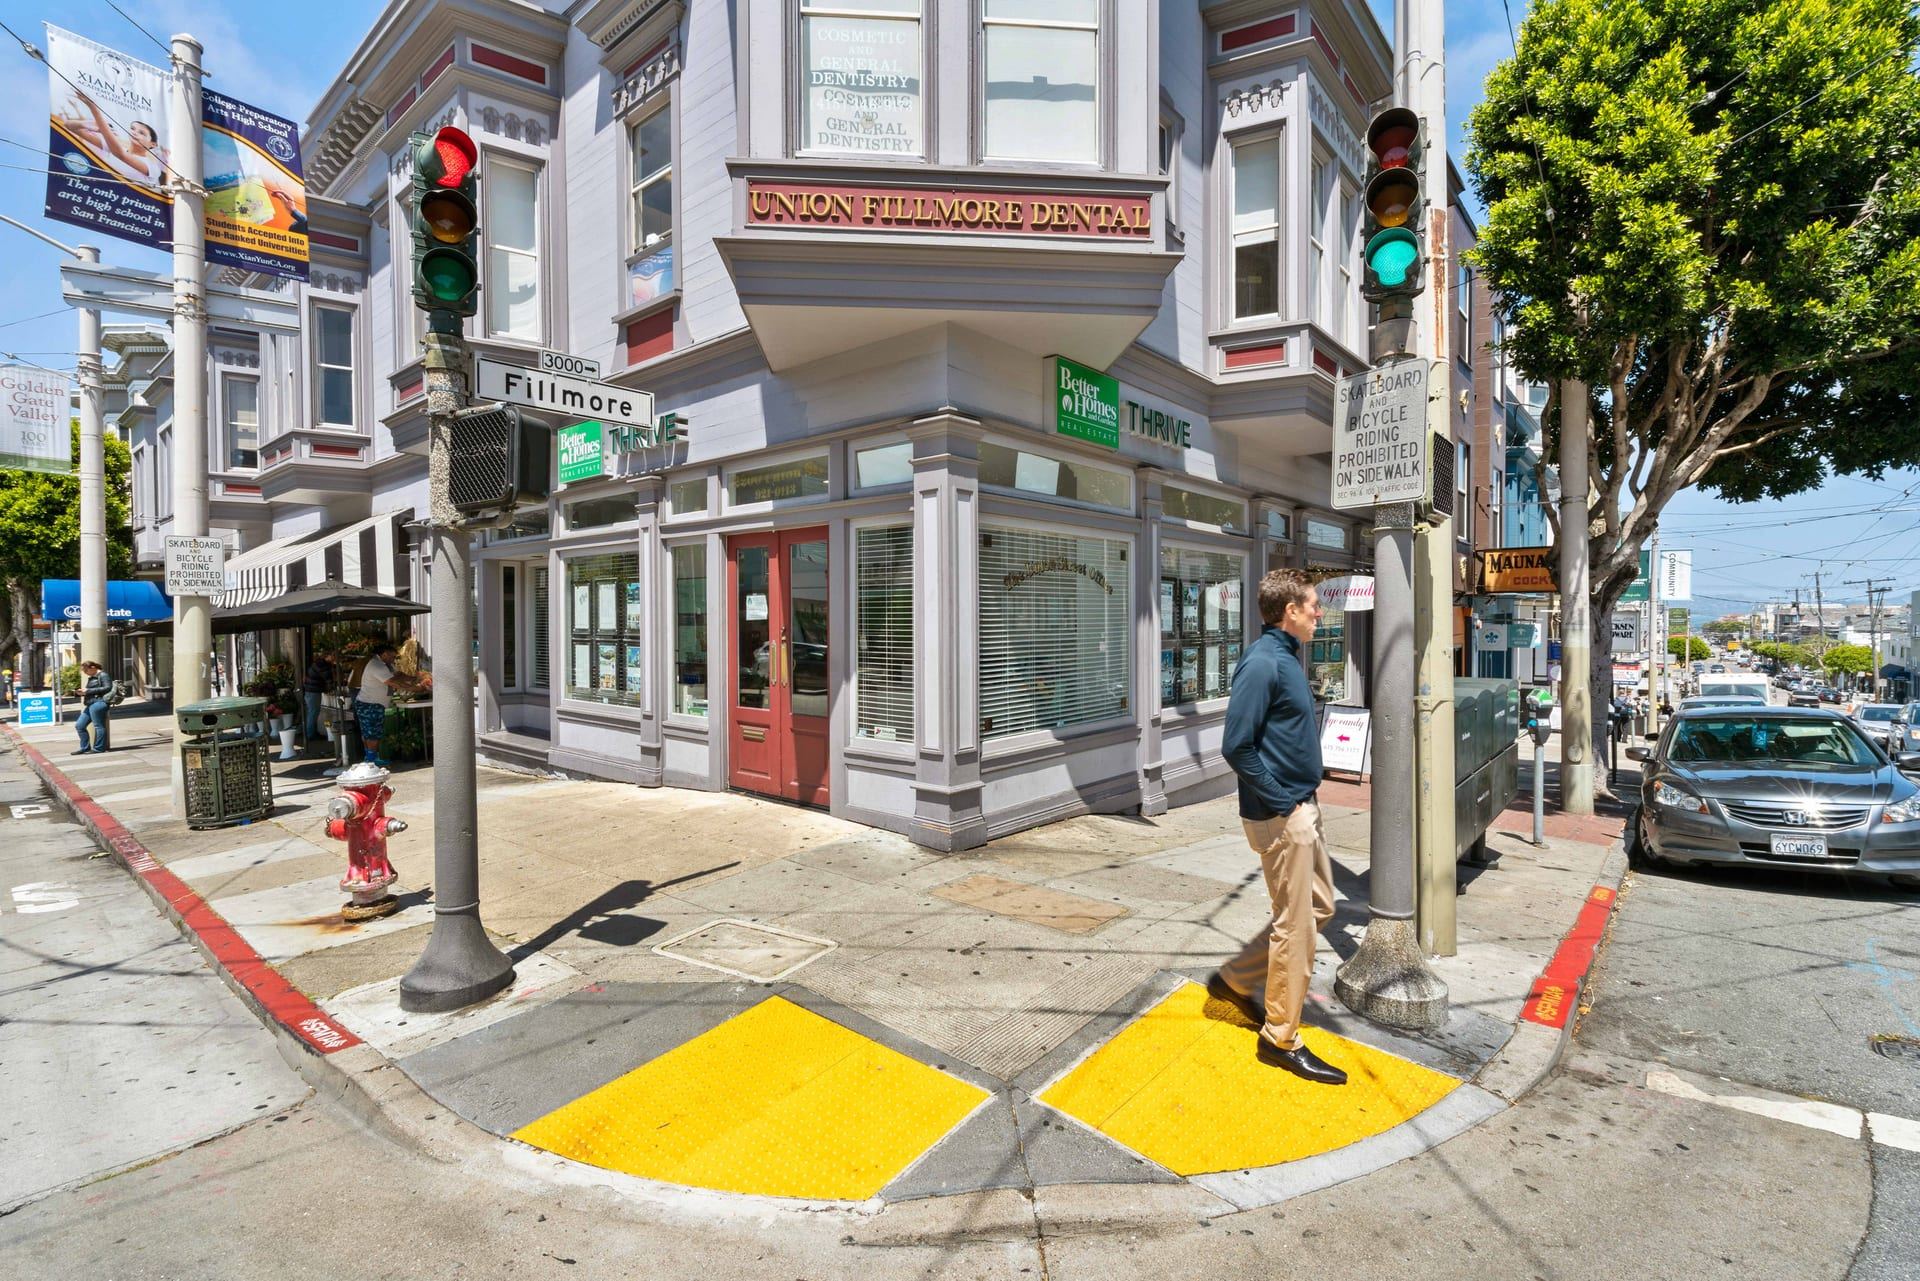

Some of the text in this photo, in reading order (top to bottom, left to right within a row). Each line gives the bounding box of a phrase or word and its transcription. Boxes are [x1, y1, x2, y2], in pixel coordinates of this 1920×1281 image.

[817, 28, 906, 44] COSMETIC
[848, 46, 873, 55] AND
[820, 56, 898, 72] GENERAL
[78, 69, 152, 107] XIAN YUN
[811, 71, 910, 88] DENTISTRY
[201, 90, 292, 132] College Preparatory
[208, 104, 288, 138] Arts High School
[66, 176, 161, 214] The only private
[58, 190, 166, 228] arts high school in
[750, 190, 1150, 233] UNION FILLMORE DENTAL
[70, 205, 152, 237] San Francisco
[206, 217, 246, 233] Students
[248, 226, 287, 242] Accepted
[204, 227, 307, 256] Top-Ranked Universities
[214, 248, 296, 272] www.XianYunCA.org
[544, 353, 584, 374] 3000
[0, 376, 65, 397] Golden
[1060, 366, 1100, 400] Better
[1340, 370, 1422, 404] SKATEBOARD
[12, 391, 55, 408] Gate
[505, 372, 632, 417] Fillmore
[1369, 396, 1388, 409] AND
[8, 404, 60, 425] Valley
[1074, 392, 1117, 421] Homes
[1127, 400, 1192, 449] THRIVE
[1350, 405, 1408, 432] BICYCLE
[21, 430, 47, 442] 100
[560, 432, 586, 451] Better
[1060, 420, 1117, 444] REAL ESTATE
[1356, 426, 1400, 448] RIDING
[568, 440, 601, 465] Homes
[1338, 441, 1418, 470] PROHIBITED
[577, 464, 600, 476] ESTATE
[1336, 460, 1420, 488] ON SIDEWALK
[1377, 484, 1400, 494] TRAFFIC
[1403, 482, 1419, 491] CODE
[168, 539, 221, 550] SKATEBOARD
[176, 554, 214, 562] BICYCLE
[181, 562, 210, 570] RIDING
[1488, 553, 1545, 574] MAUNA
[168, 578, 222, 587] ON SIDEWALK
[170, 570, 220, 579] PROHIBITED
[1513, 576, 1550, 586] COCK
[1668, 552, 1676, 597] COMMUNITY
[1323, 588, 1342, 602] eye
